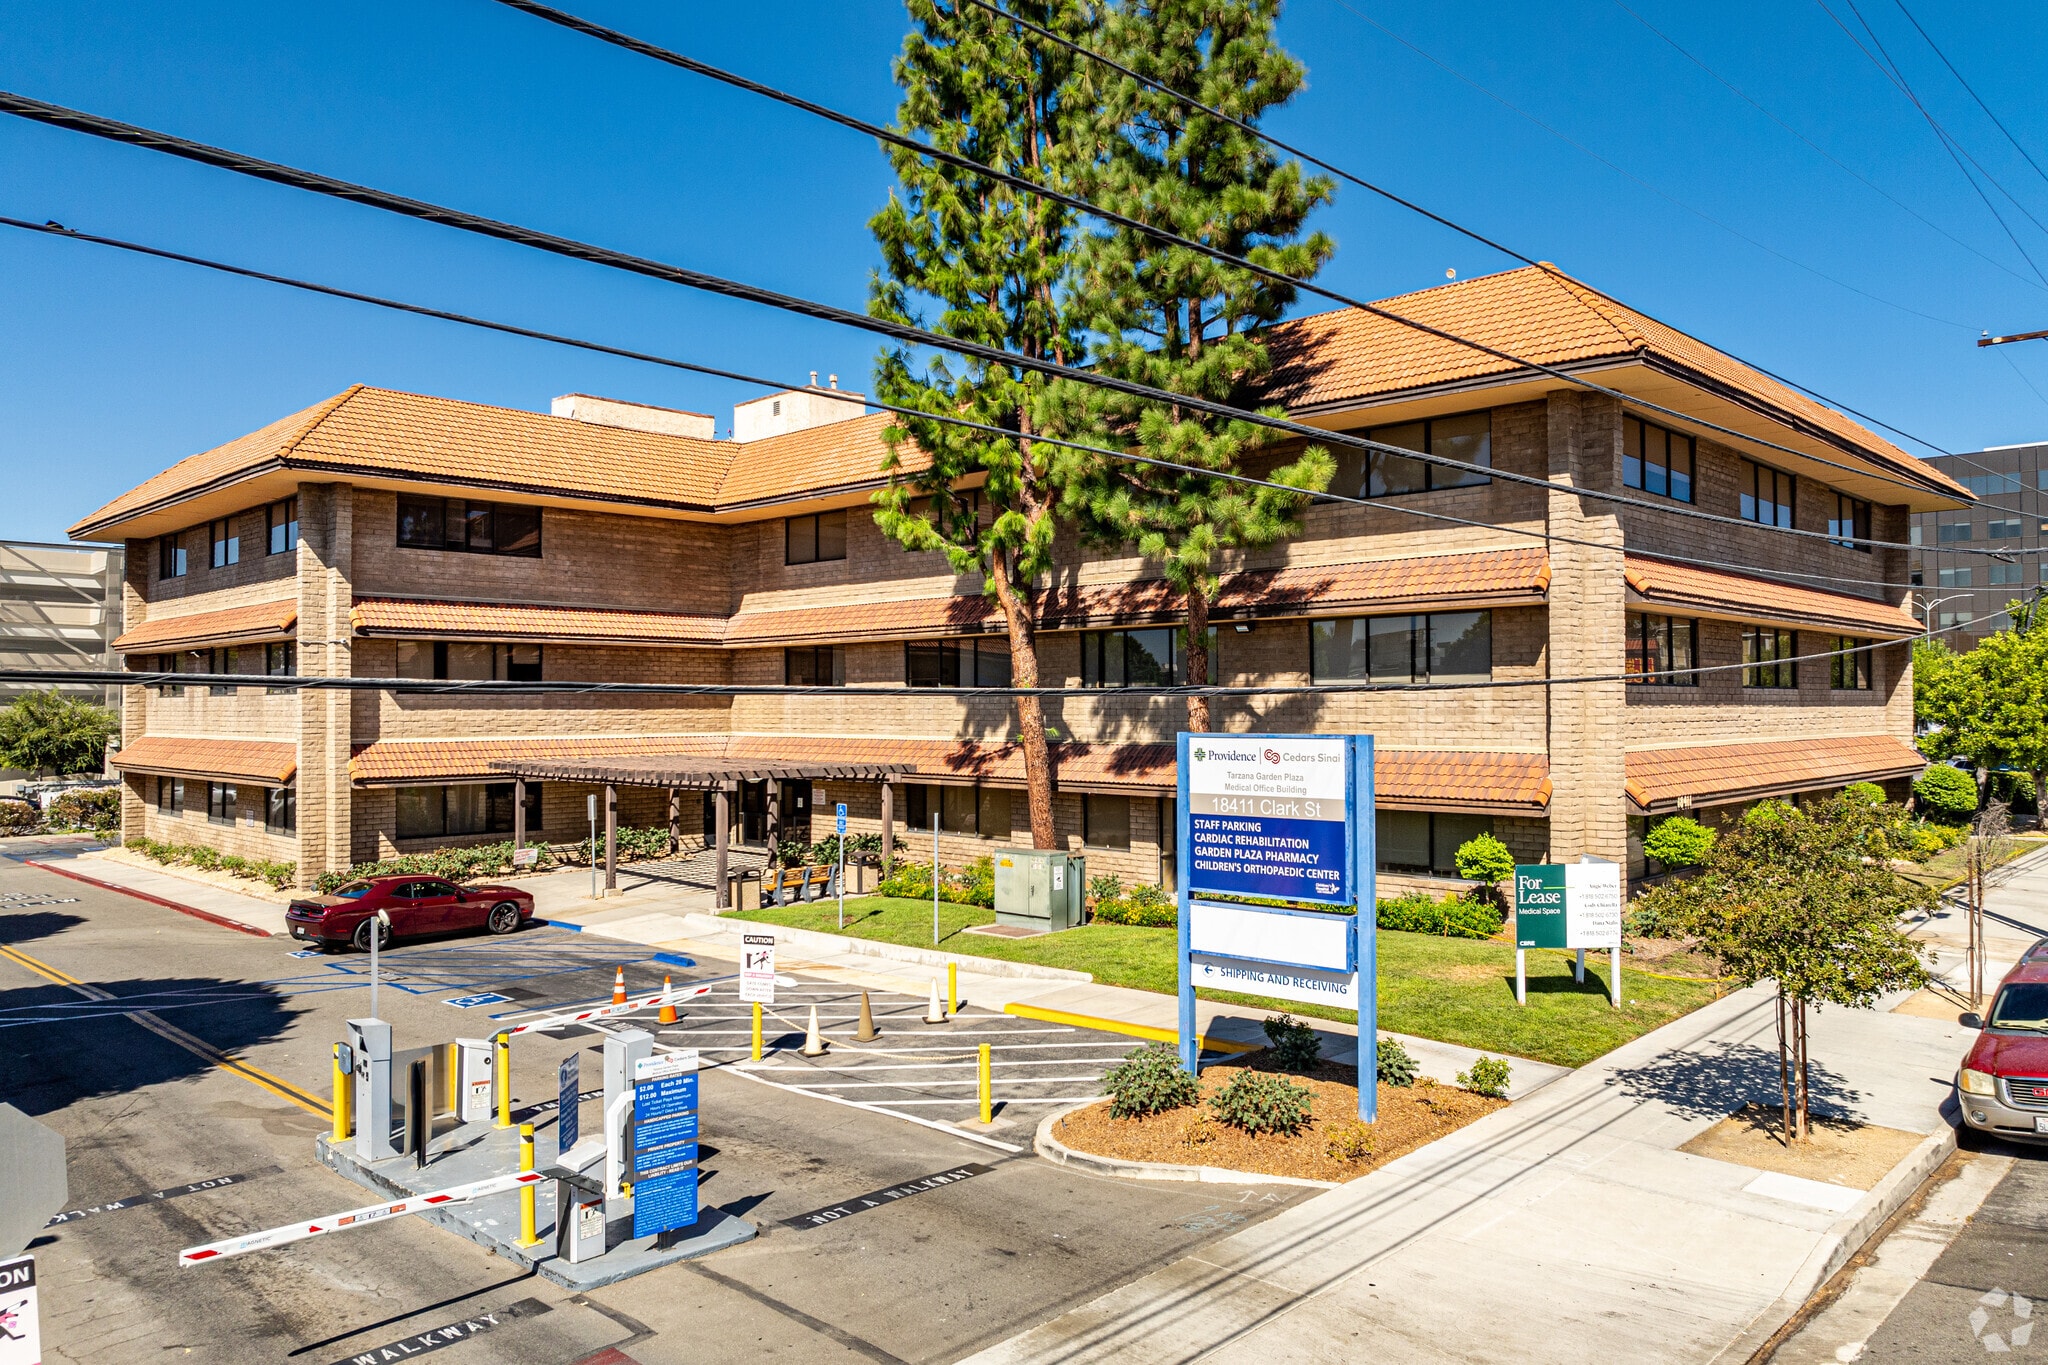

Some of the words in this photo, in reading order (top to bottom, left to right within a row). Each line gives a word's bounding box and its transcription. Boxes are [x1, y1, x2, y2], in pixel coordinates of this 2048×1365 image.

[1209, 750, 1256, 762] Providence
[1283, 753, 1315, 763] Cedars
[1318, 754, 1340, 763] Sinai
[1227, 771, 1254, 780] Tarzana
[1256, 772, 1282, 781] Garden
[1284, 774, 1304, 782] Plaza
[1225, 783, 1251, 792] Medical
[1253, 784, 1275, 793] Office
[1277, 785, 1307, 795] Building
[1213, 798, 1254, 813] 18411
[1260, 799, 1299, 816] Clark
[1305, 801, 1321, 817] St
[1195, 820, 1220, 830] STAFF
[1222, 821, 1261, 832] PARKING
[1195, 833, 1233, 844] CARDIAC
[1235, 835, 1309, 849] REHABILITATION
[1195, 846, 1232, 858] GARDEN
[1234, 849, 1262, 861] PLAZA
[1265, 852, 1319, 864] PHARMACY
[1195, 860, 1241, 872] CHILDREN'S
[1244, 864, 1304, 877] ORTHOPAEDIC
[1306, 870, 1340, 880] CENTER
[1519, 876, 1542, 890] For
[1519, 890, 1560, 904] Lease
[1220, 968, 1264, 982] SHIPPING
[1267, 974, 1289, 986] AND
[1293, 979, 1347, 994] RECEIVING
[640, 1092, 656, 1100] $12.00
[661, 1088, 686, 1096] Maximum
[806, 1207, 851, 1225] NOT
[862, 1200, 879, 1208] A
[883, 1169, 974, 1200] WALKWAY
[46, 1202, 124, 1226] WALK
[352, 1314, 500, 1365] WALKWAY
